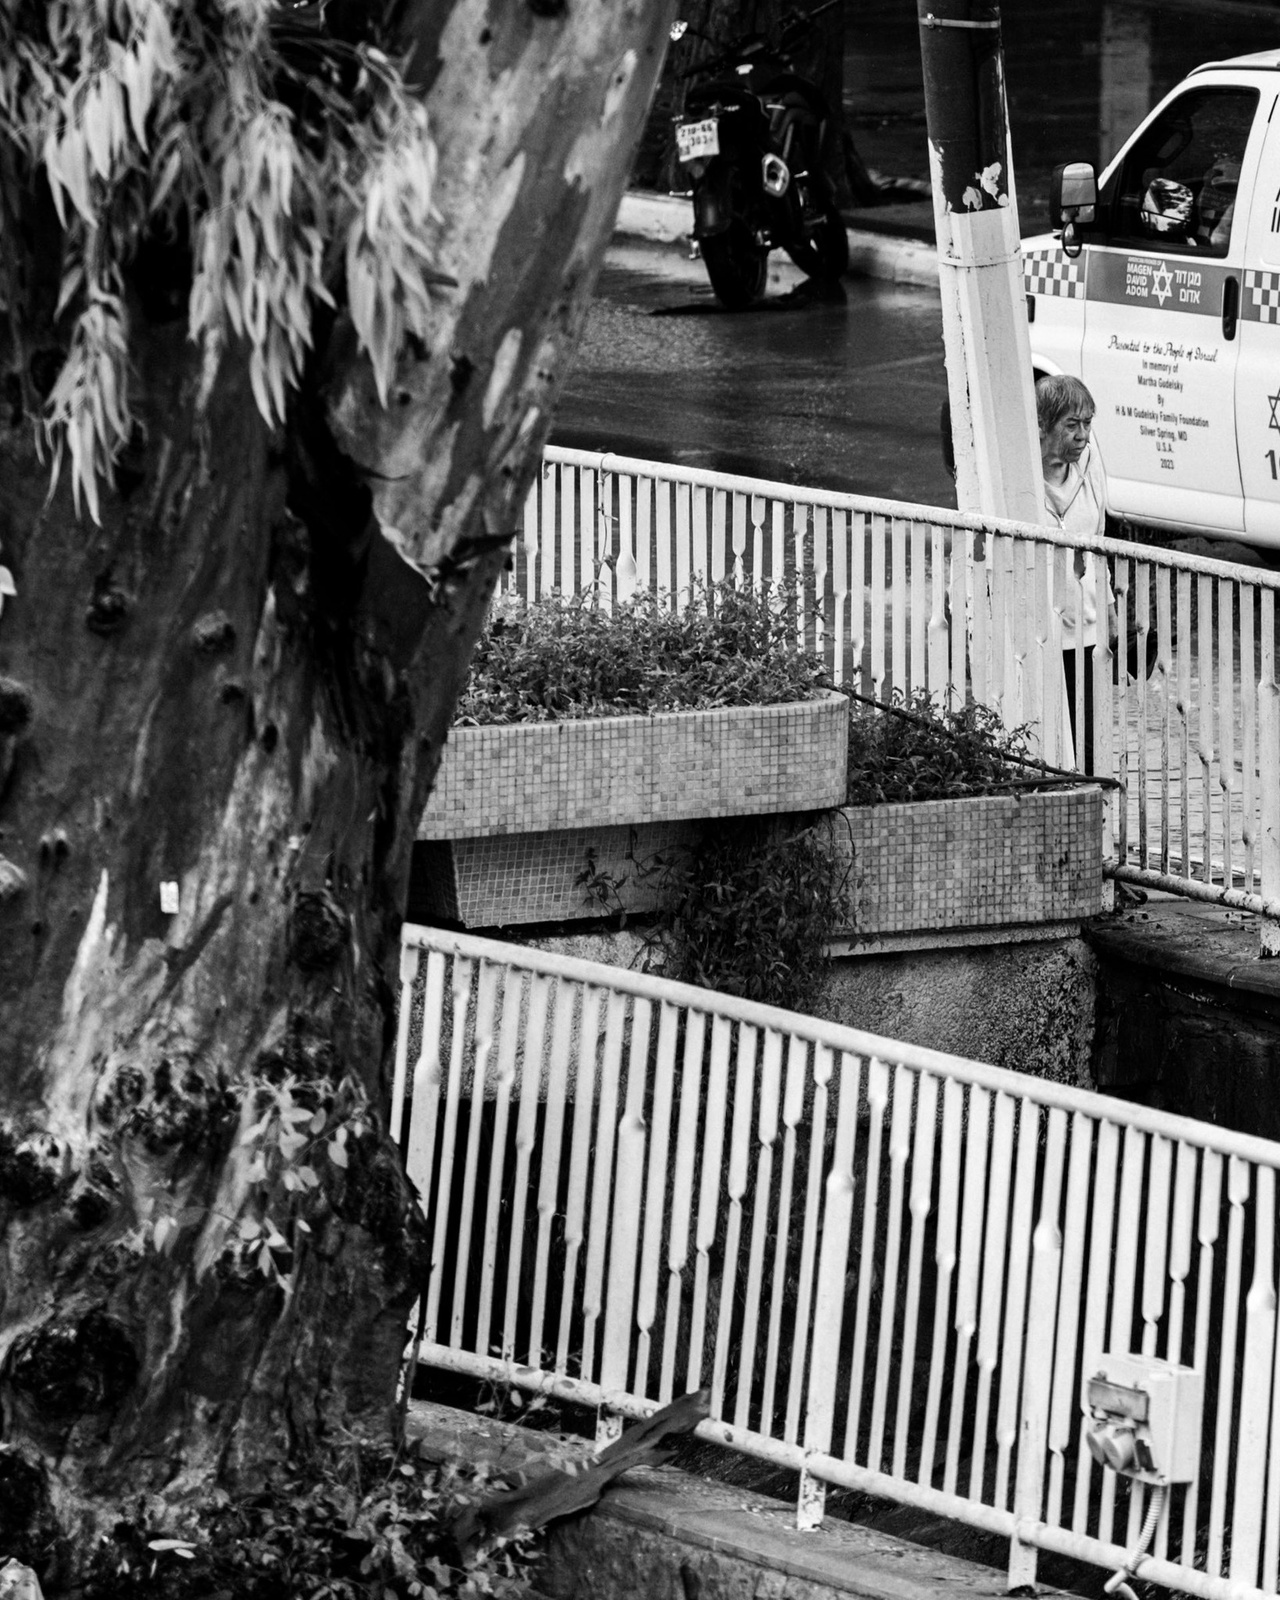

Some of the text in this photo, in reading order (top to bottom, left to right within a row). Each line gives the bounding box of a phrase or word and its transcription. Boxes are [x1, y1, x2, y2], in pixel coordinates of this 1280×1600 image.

[1127, 263, 1152, 276] MAGEN
[1126, 274, 1147, 286] DAVID
[1174, 269, 1202, 288] מגן דוד
[1126, 285, 1148, 297] ADOM
[1178, 288, 1201, 304] אדום
[1107, 334, 1218, 363] Presented to the People of Israel
[1142, 359, 1179, 375] In memory of
[1137, 375, 1157, 387] Martha
[1157, 393, 1165, 407] By
[1115, 405, 1121, 416] H
[1127, 406, 1133, 417] M
[1159, 411, 1178, 426] Family
[1178, 413, 1210, 428] Foundation
[1140, 424, 1156, 436] Silver
[1177, 430, 1188, 441] MD
